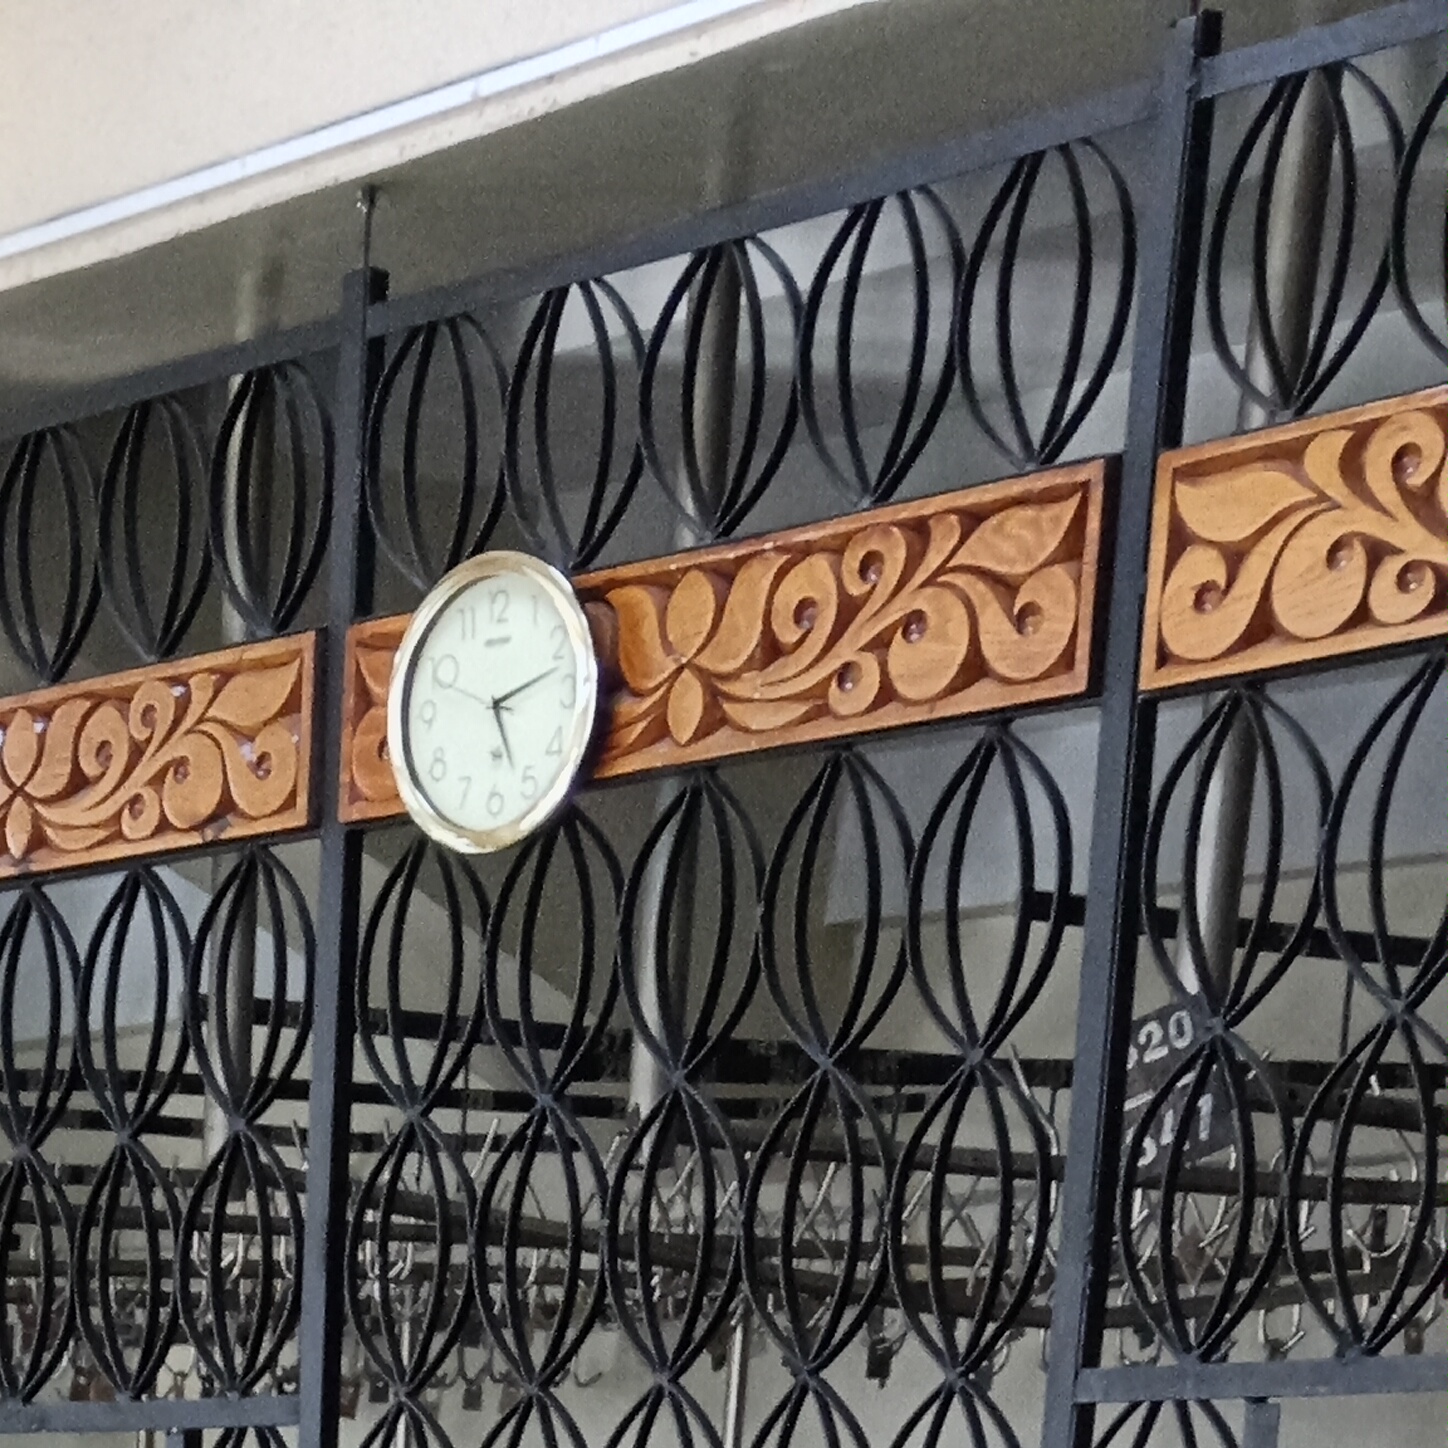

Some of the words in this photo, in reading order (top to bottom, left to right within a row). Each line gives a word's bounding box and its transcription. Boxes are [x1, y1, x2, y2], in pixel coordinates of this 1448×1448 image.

[459, 605, 477, 641] 11
[489, 589, 510, 624] 12
[550, 624, 567, 660] 2
[427, 654, 459, 690] 10
[420, 699, 437, 731] 9
[545, 725, 563, 757] 4
[430, 746, 446, 782] 8
[458, 775, 473, 810] 7
[520, 765, 538, 799] 5
[486, 784, 504, 817] 6
